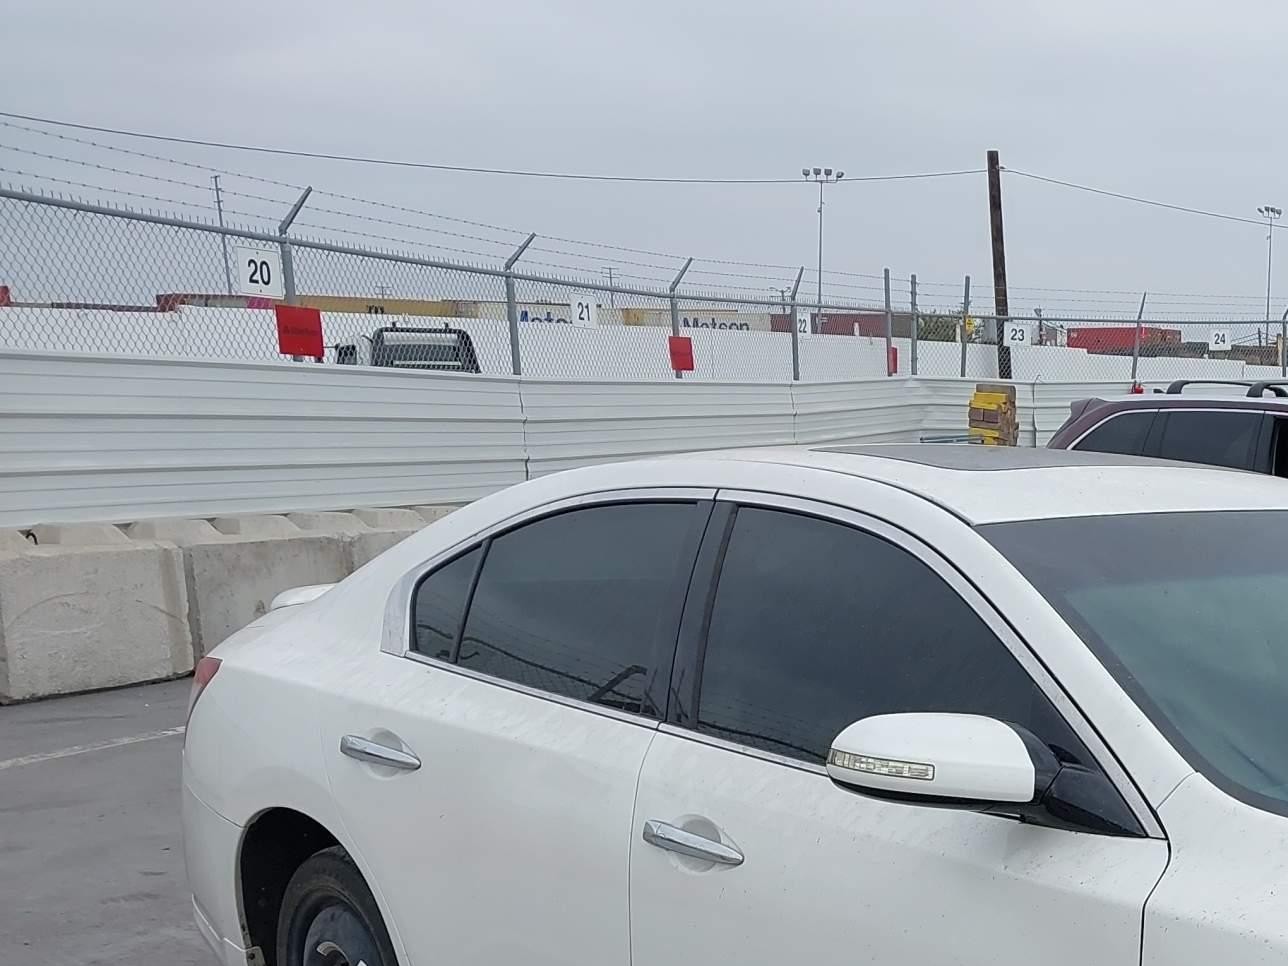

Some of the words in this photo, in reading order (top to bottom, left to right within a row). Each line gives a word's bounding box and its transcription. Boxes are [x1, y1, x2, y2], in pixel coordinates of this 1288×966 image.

[247, 259, 271, 286] 20
[577, 301, 590, 321] 21
[798, 319, 807, 334] 22
[1010, 328, 1025, 341] 23
[1214, 332, 1226, 345] 24
